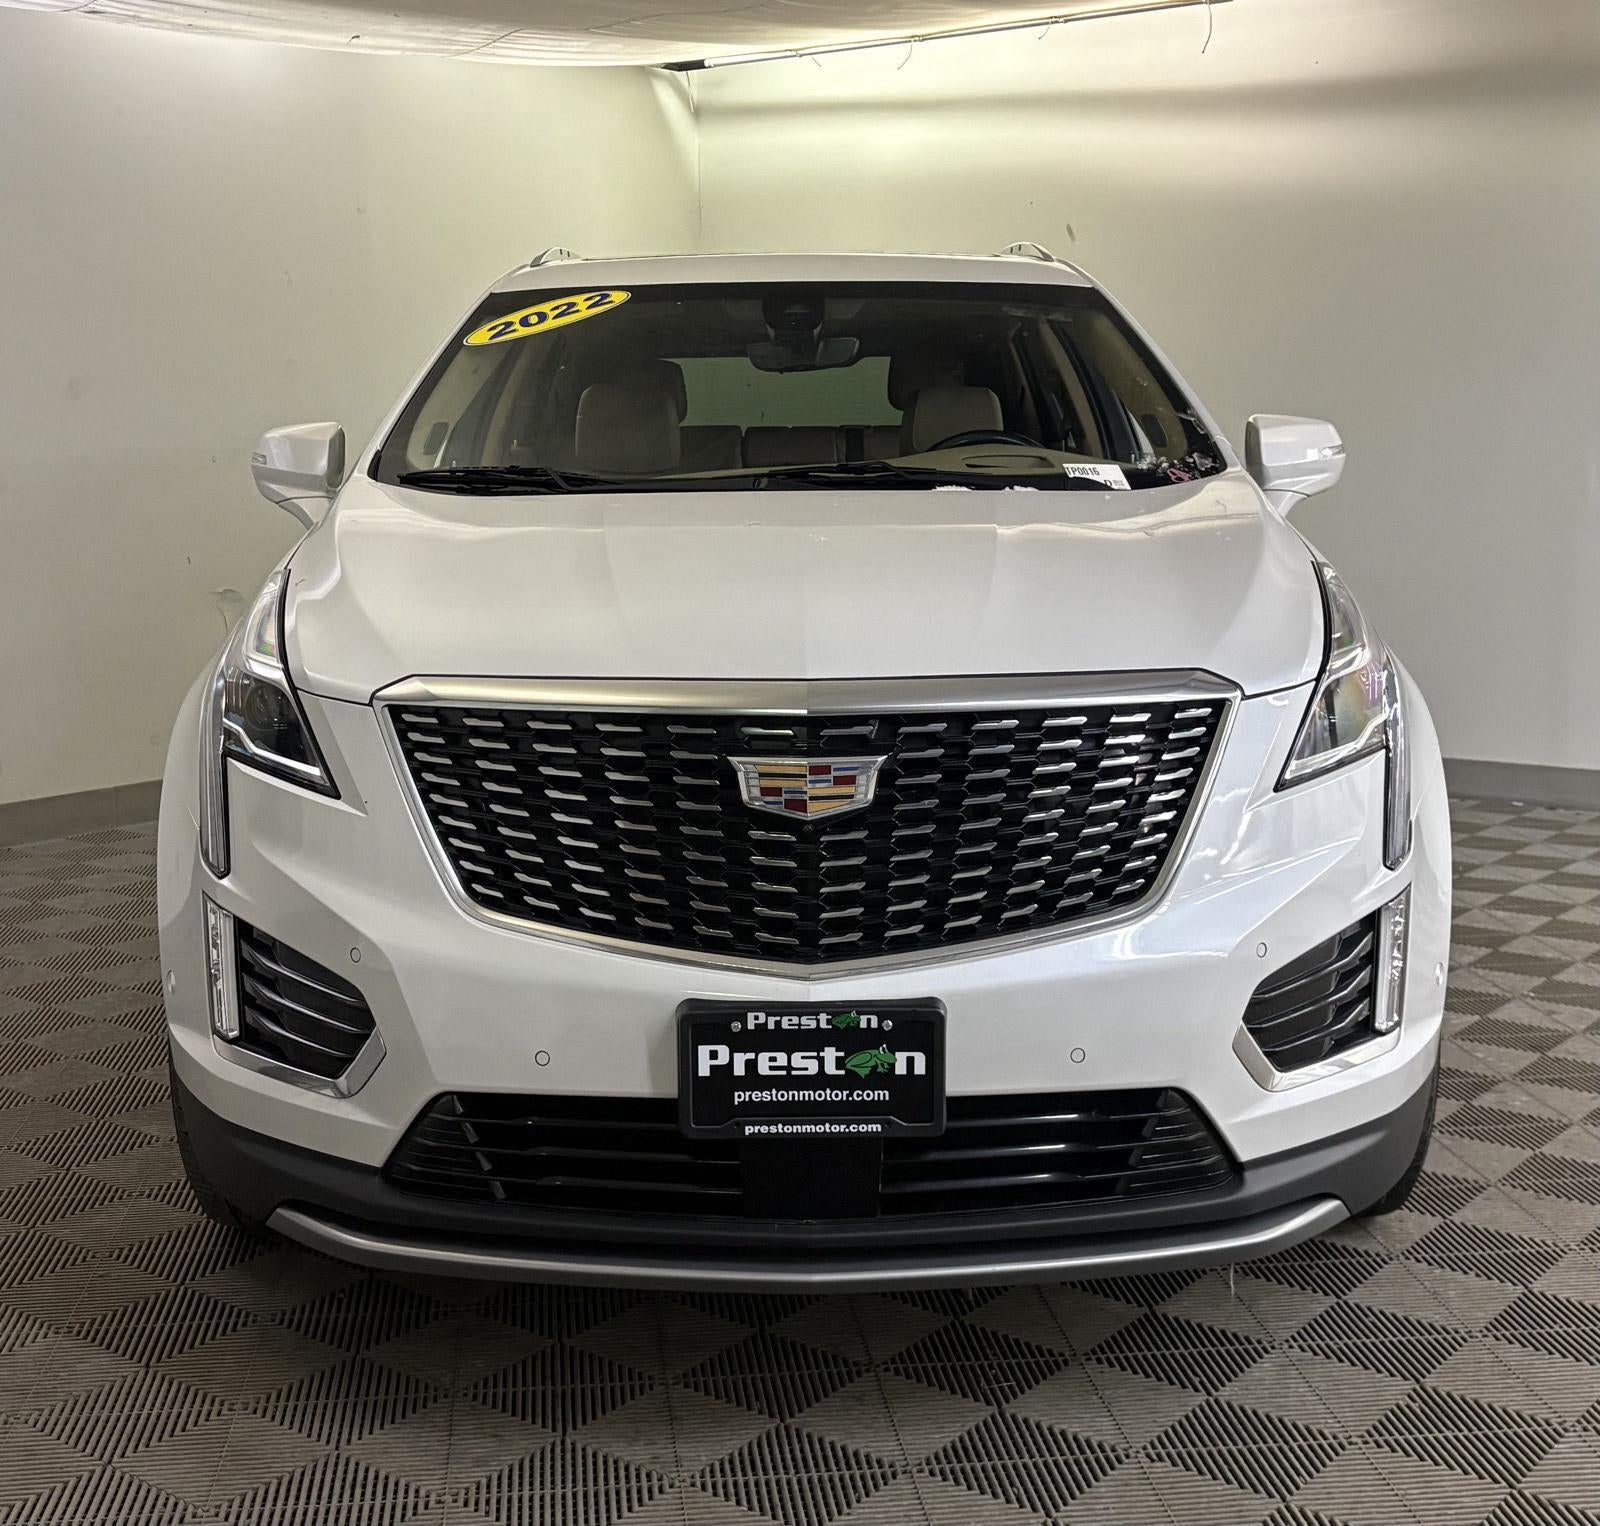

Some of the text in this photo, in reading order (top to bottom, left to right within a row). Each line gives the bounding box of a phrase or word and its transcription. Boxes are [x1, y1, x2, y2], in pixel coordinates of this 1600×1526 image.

[486, 292, 616, 342] 2022
[746, 1011, 879, 1030] Prestn
[697, 1043, 927, 1078] Prestn
[733, 1087, 890, 1106] prestonmotor.com
[744, 1122, 882, 1136] prestonmotor.com
